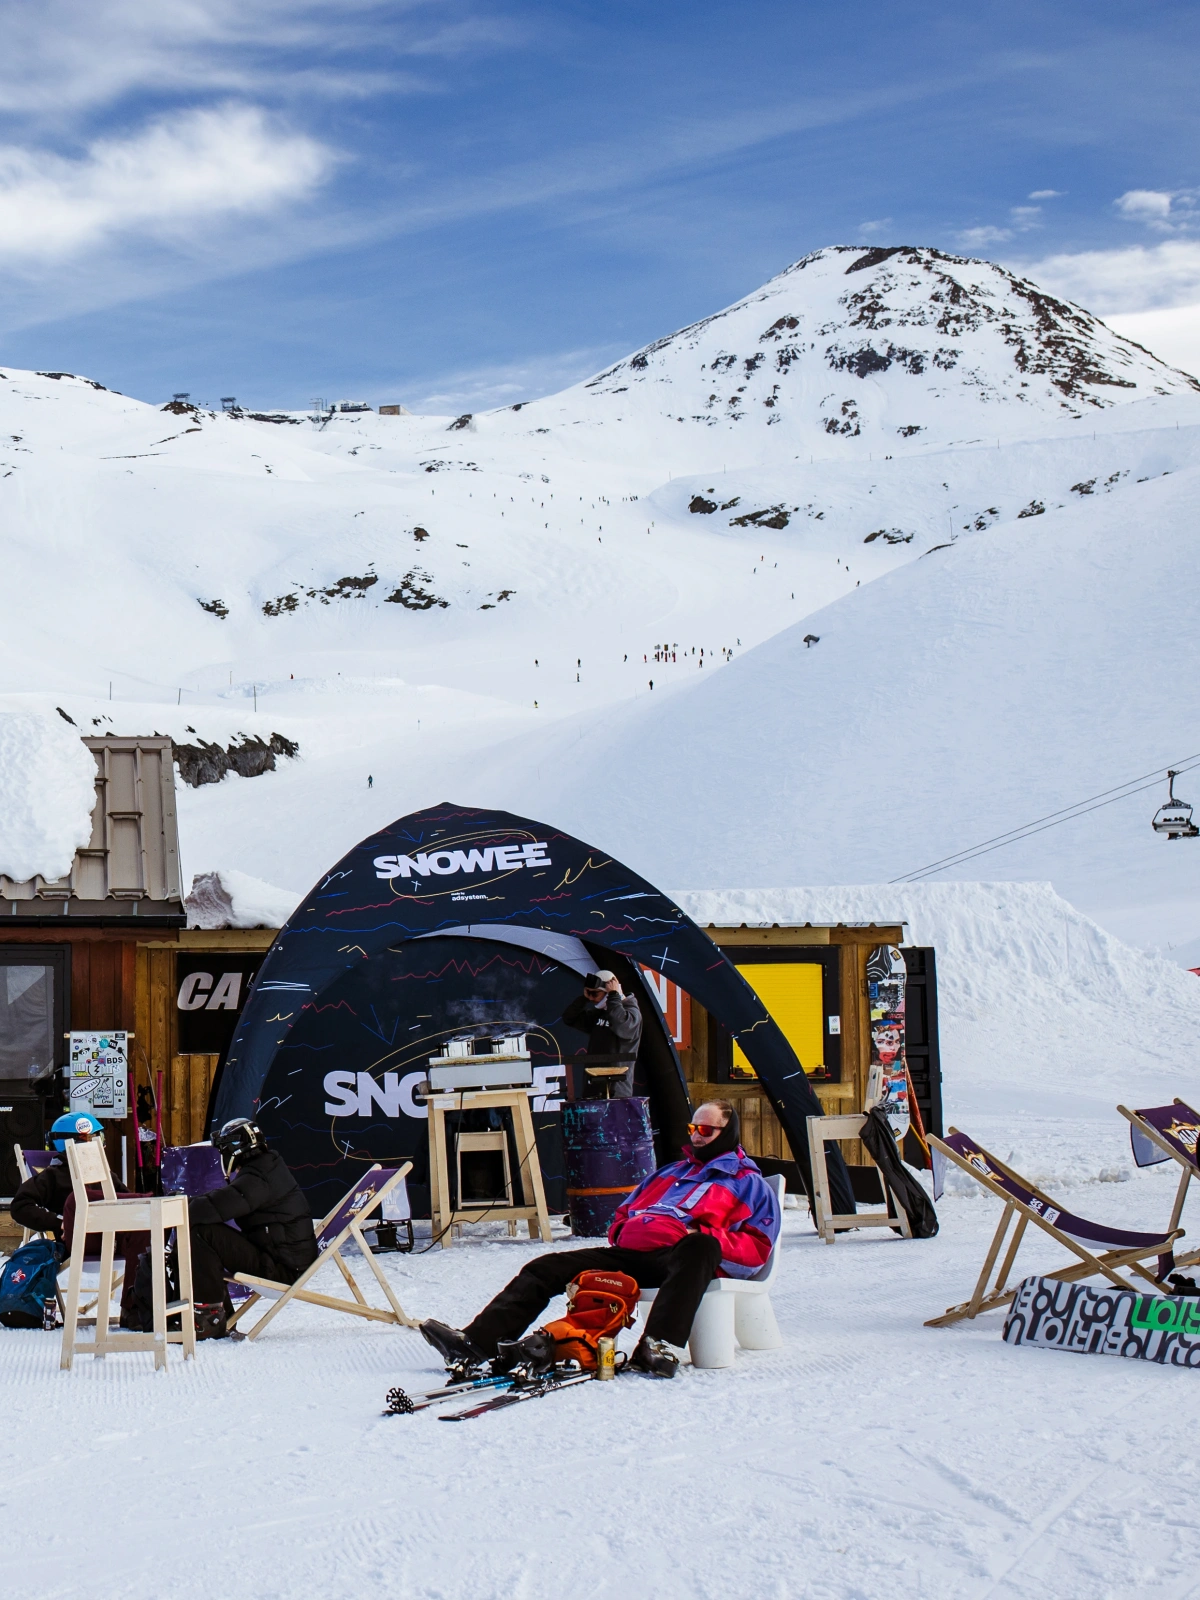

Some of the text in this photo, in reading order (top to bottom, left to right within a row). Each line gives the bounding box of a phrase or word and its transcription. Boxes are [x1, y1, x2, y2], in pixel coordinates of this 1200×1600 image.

[373, 842, 552, 879] SNOWEE
[177, 972, 254, 1010] CA
[106, 1056, 123, 1064] BDS
[594, 1276, 623, 1287] DAKINE
